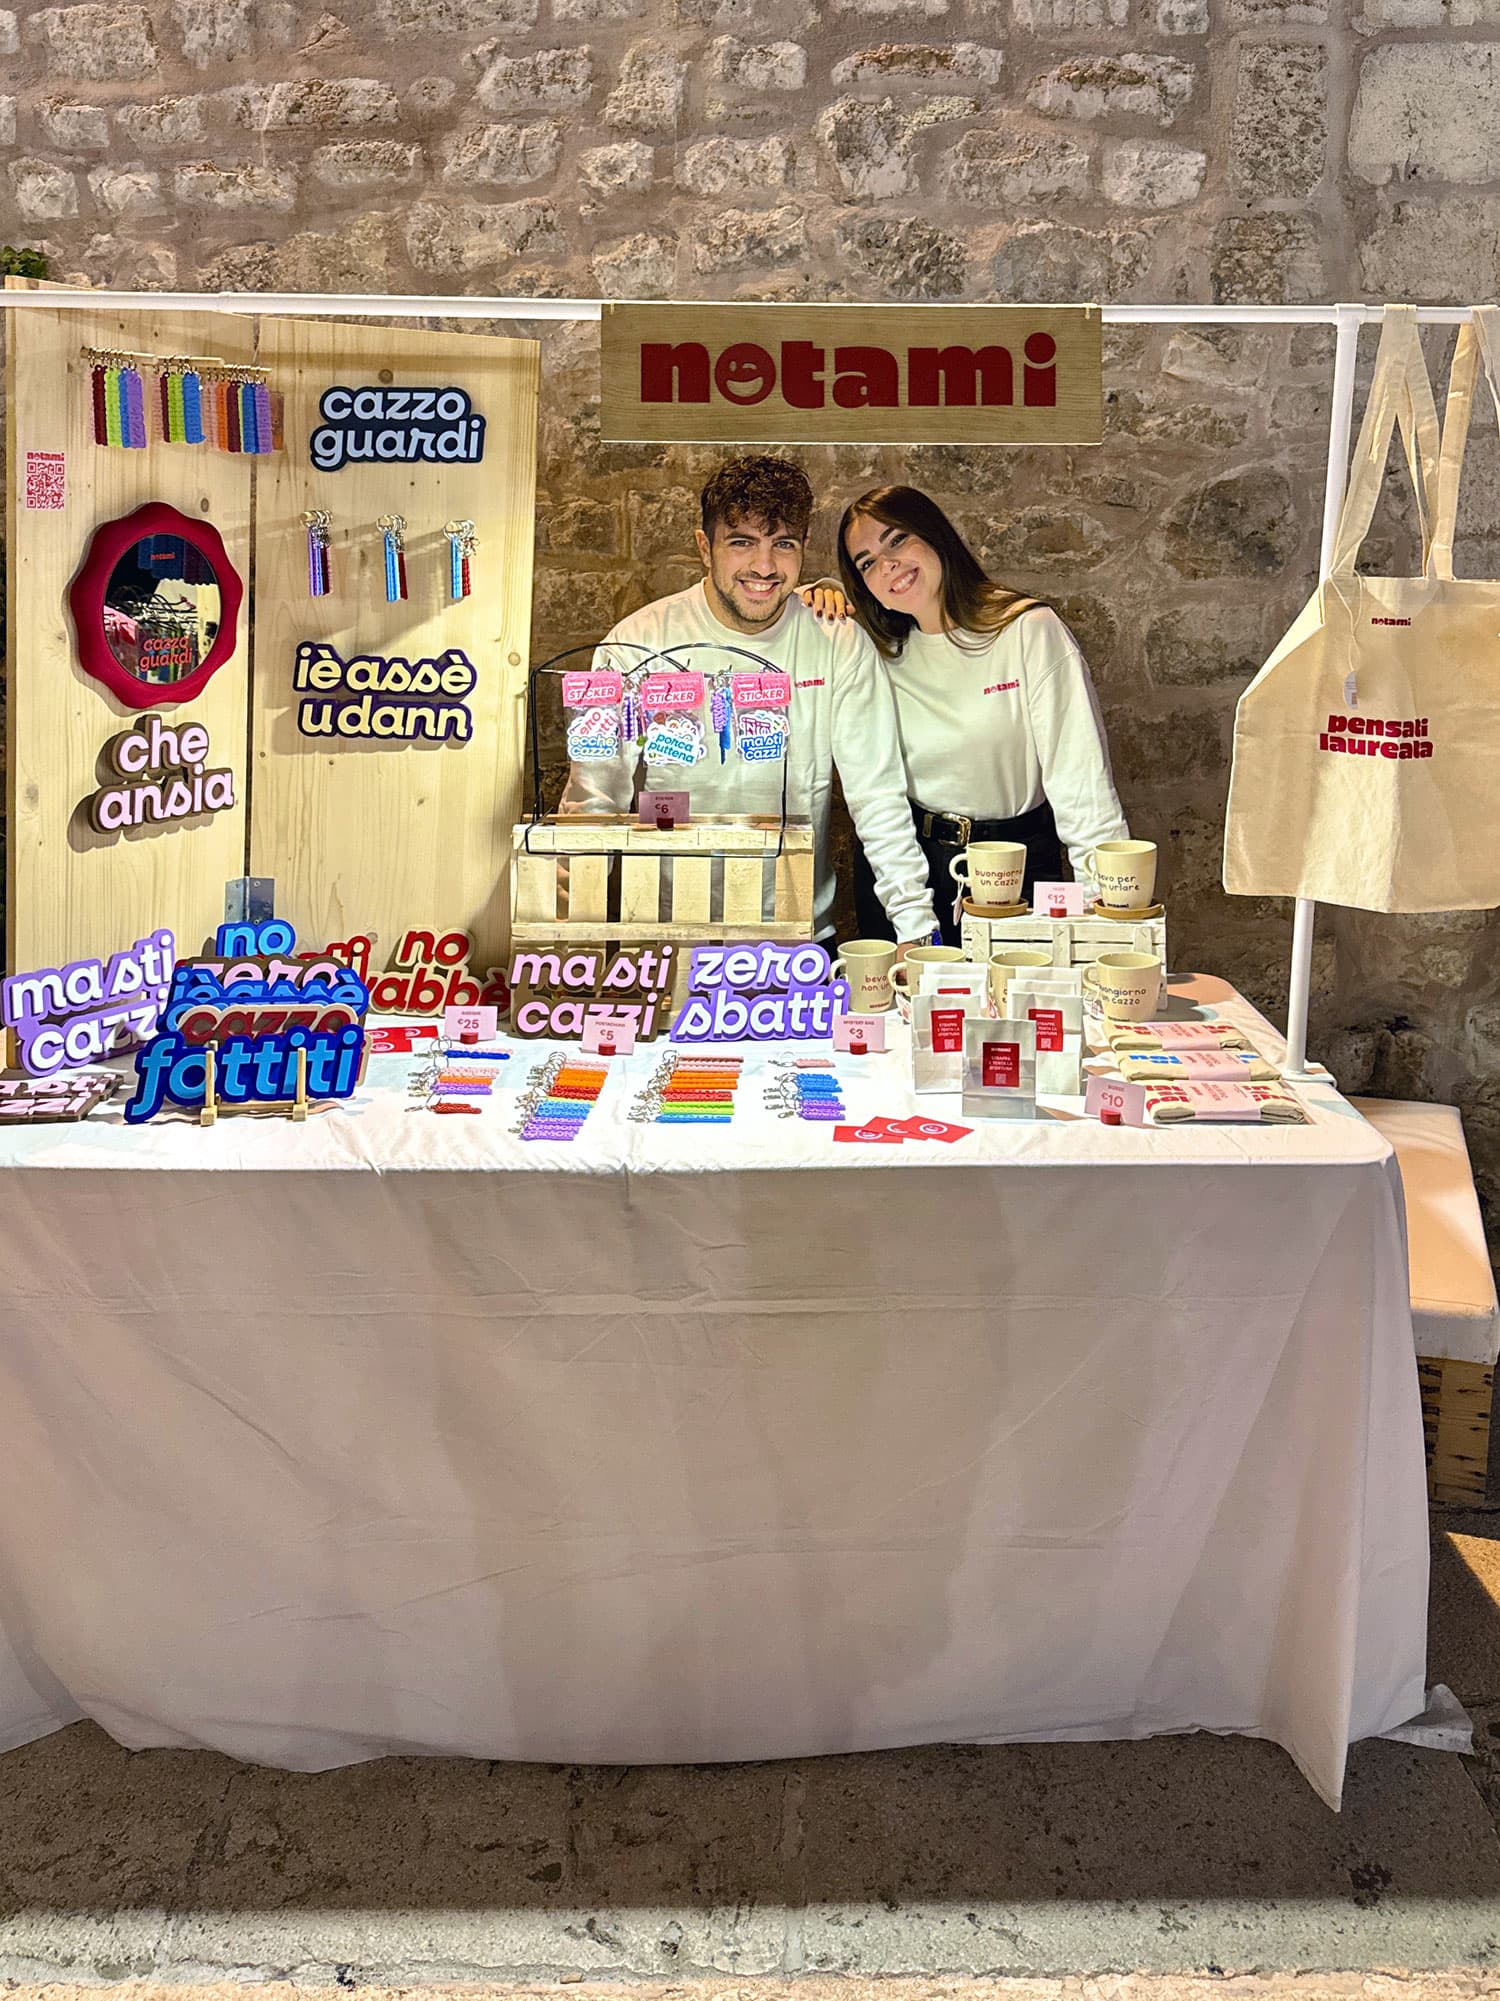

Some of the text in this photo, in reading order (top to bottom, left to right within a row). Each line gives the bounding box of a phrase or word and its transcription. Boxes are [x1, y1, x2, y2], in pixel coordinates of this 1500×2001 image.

[641, 332, 1056, 408] notami
[323, 391, 466, 420] cazzo
[314, 419, 480, 467] guardi
[1371, 617, 1411, 626] notami
[144, 636, 188, 651] cazzo
[140, 648, 192, 671] guardi
[569, 687, 616, 700] STICKER
[984, 678, 1020, 695] notami
[648, 690, 695, 703] STICKER
[738, 689, 784, 701] STICKER
[119, 719, 208, 773] che
[656, 733, 694, 752] porca
[745, 746, 781, 760] cazzi
[99, 763, 234, 829] ansia
[655, 803, 669, 814] €6
[994, 878, 1019, 887] cazzo
[1117, 876, 1136, 885] per
[1048, 894, 1065, 904] €12
[223, 924, 292, 958] no
[399, 930, 470, 966] no
[694, 947, 824, 985] zero
[865, 975, 887, 983] bevo
[1099, 984, 1147, 998] uongiorno
[676, 984, 845, 1034] sbatti
[457, 1018, 479, 1029] €25
[600, 1029, 614, 1041] €5
[850, 1027, 863, 1039] €3
[131, 1030, 358, 1117] fottiti
[0, 1091, 92, 1116] zzi
[1101, 1091, 1123, 1108] €10
